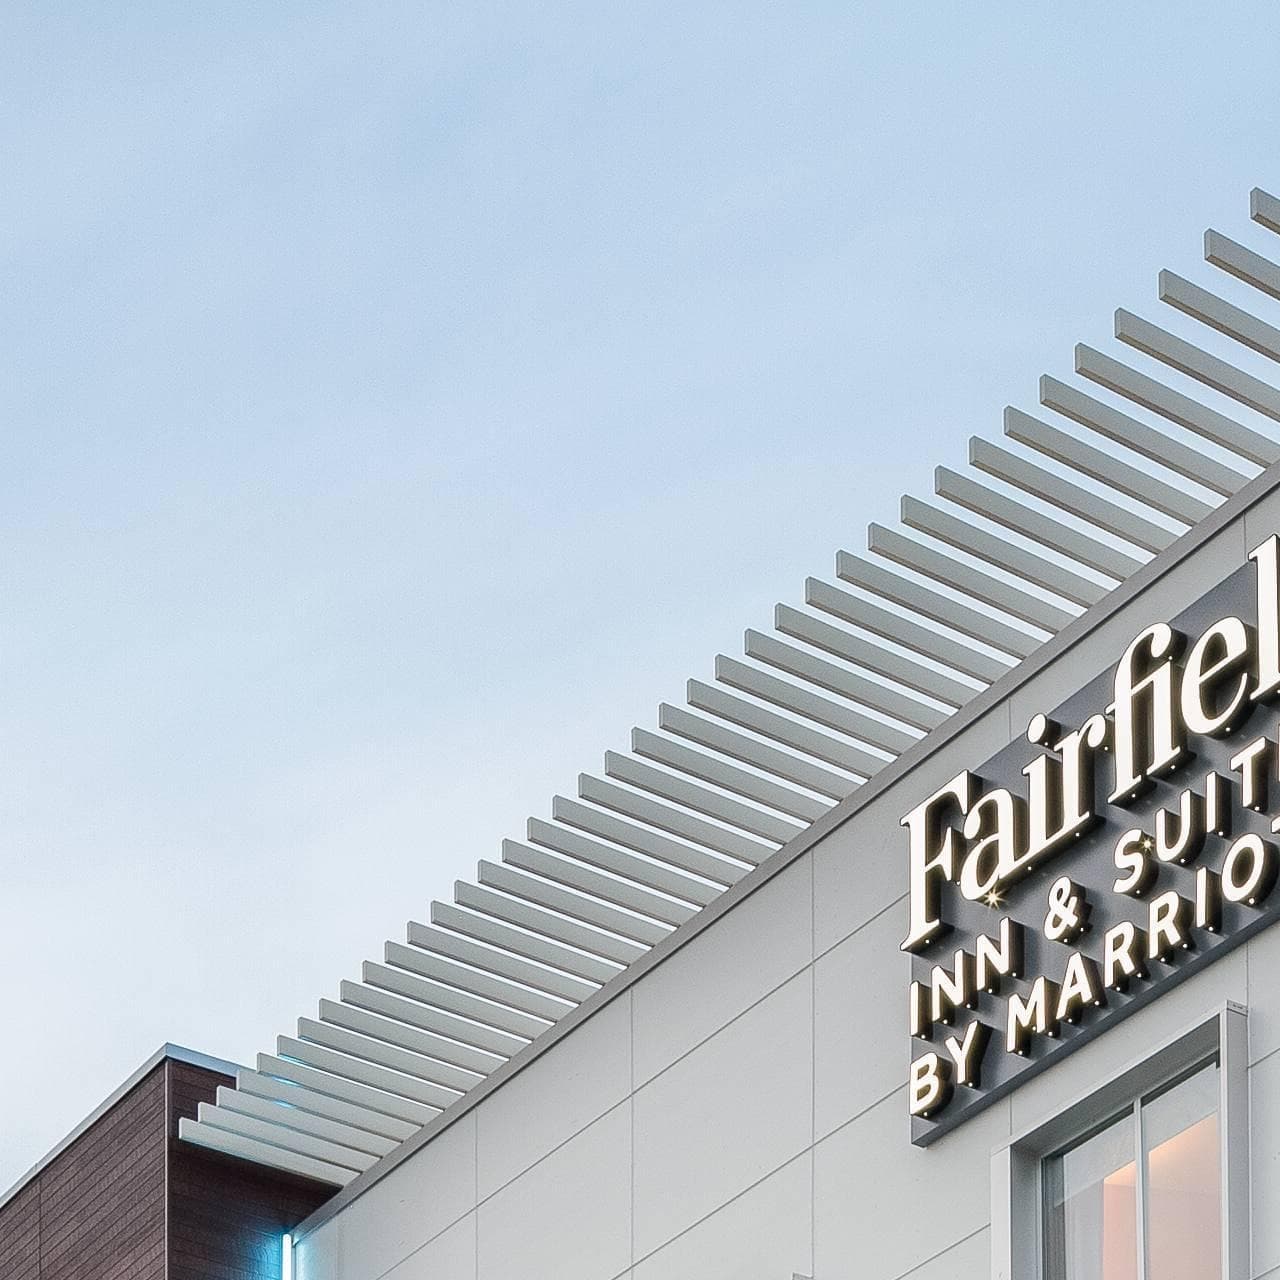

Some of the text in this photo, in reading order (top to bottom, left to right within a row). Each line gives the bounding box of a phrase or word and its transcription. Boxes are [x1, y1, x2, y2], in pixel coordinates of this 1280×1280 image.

[910, 917, 1014, 1041] INN
[1044, 876, 1081, 942] &
[910, 1021, 986, 1116] BY
